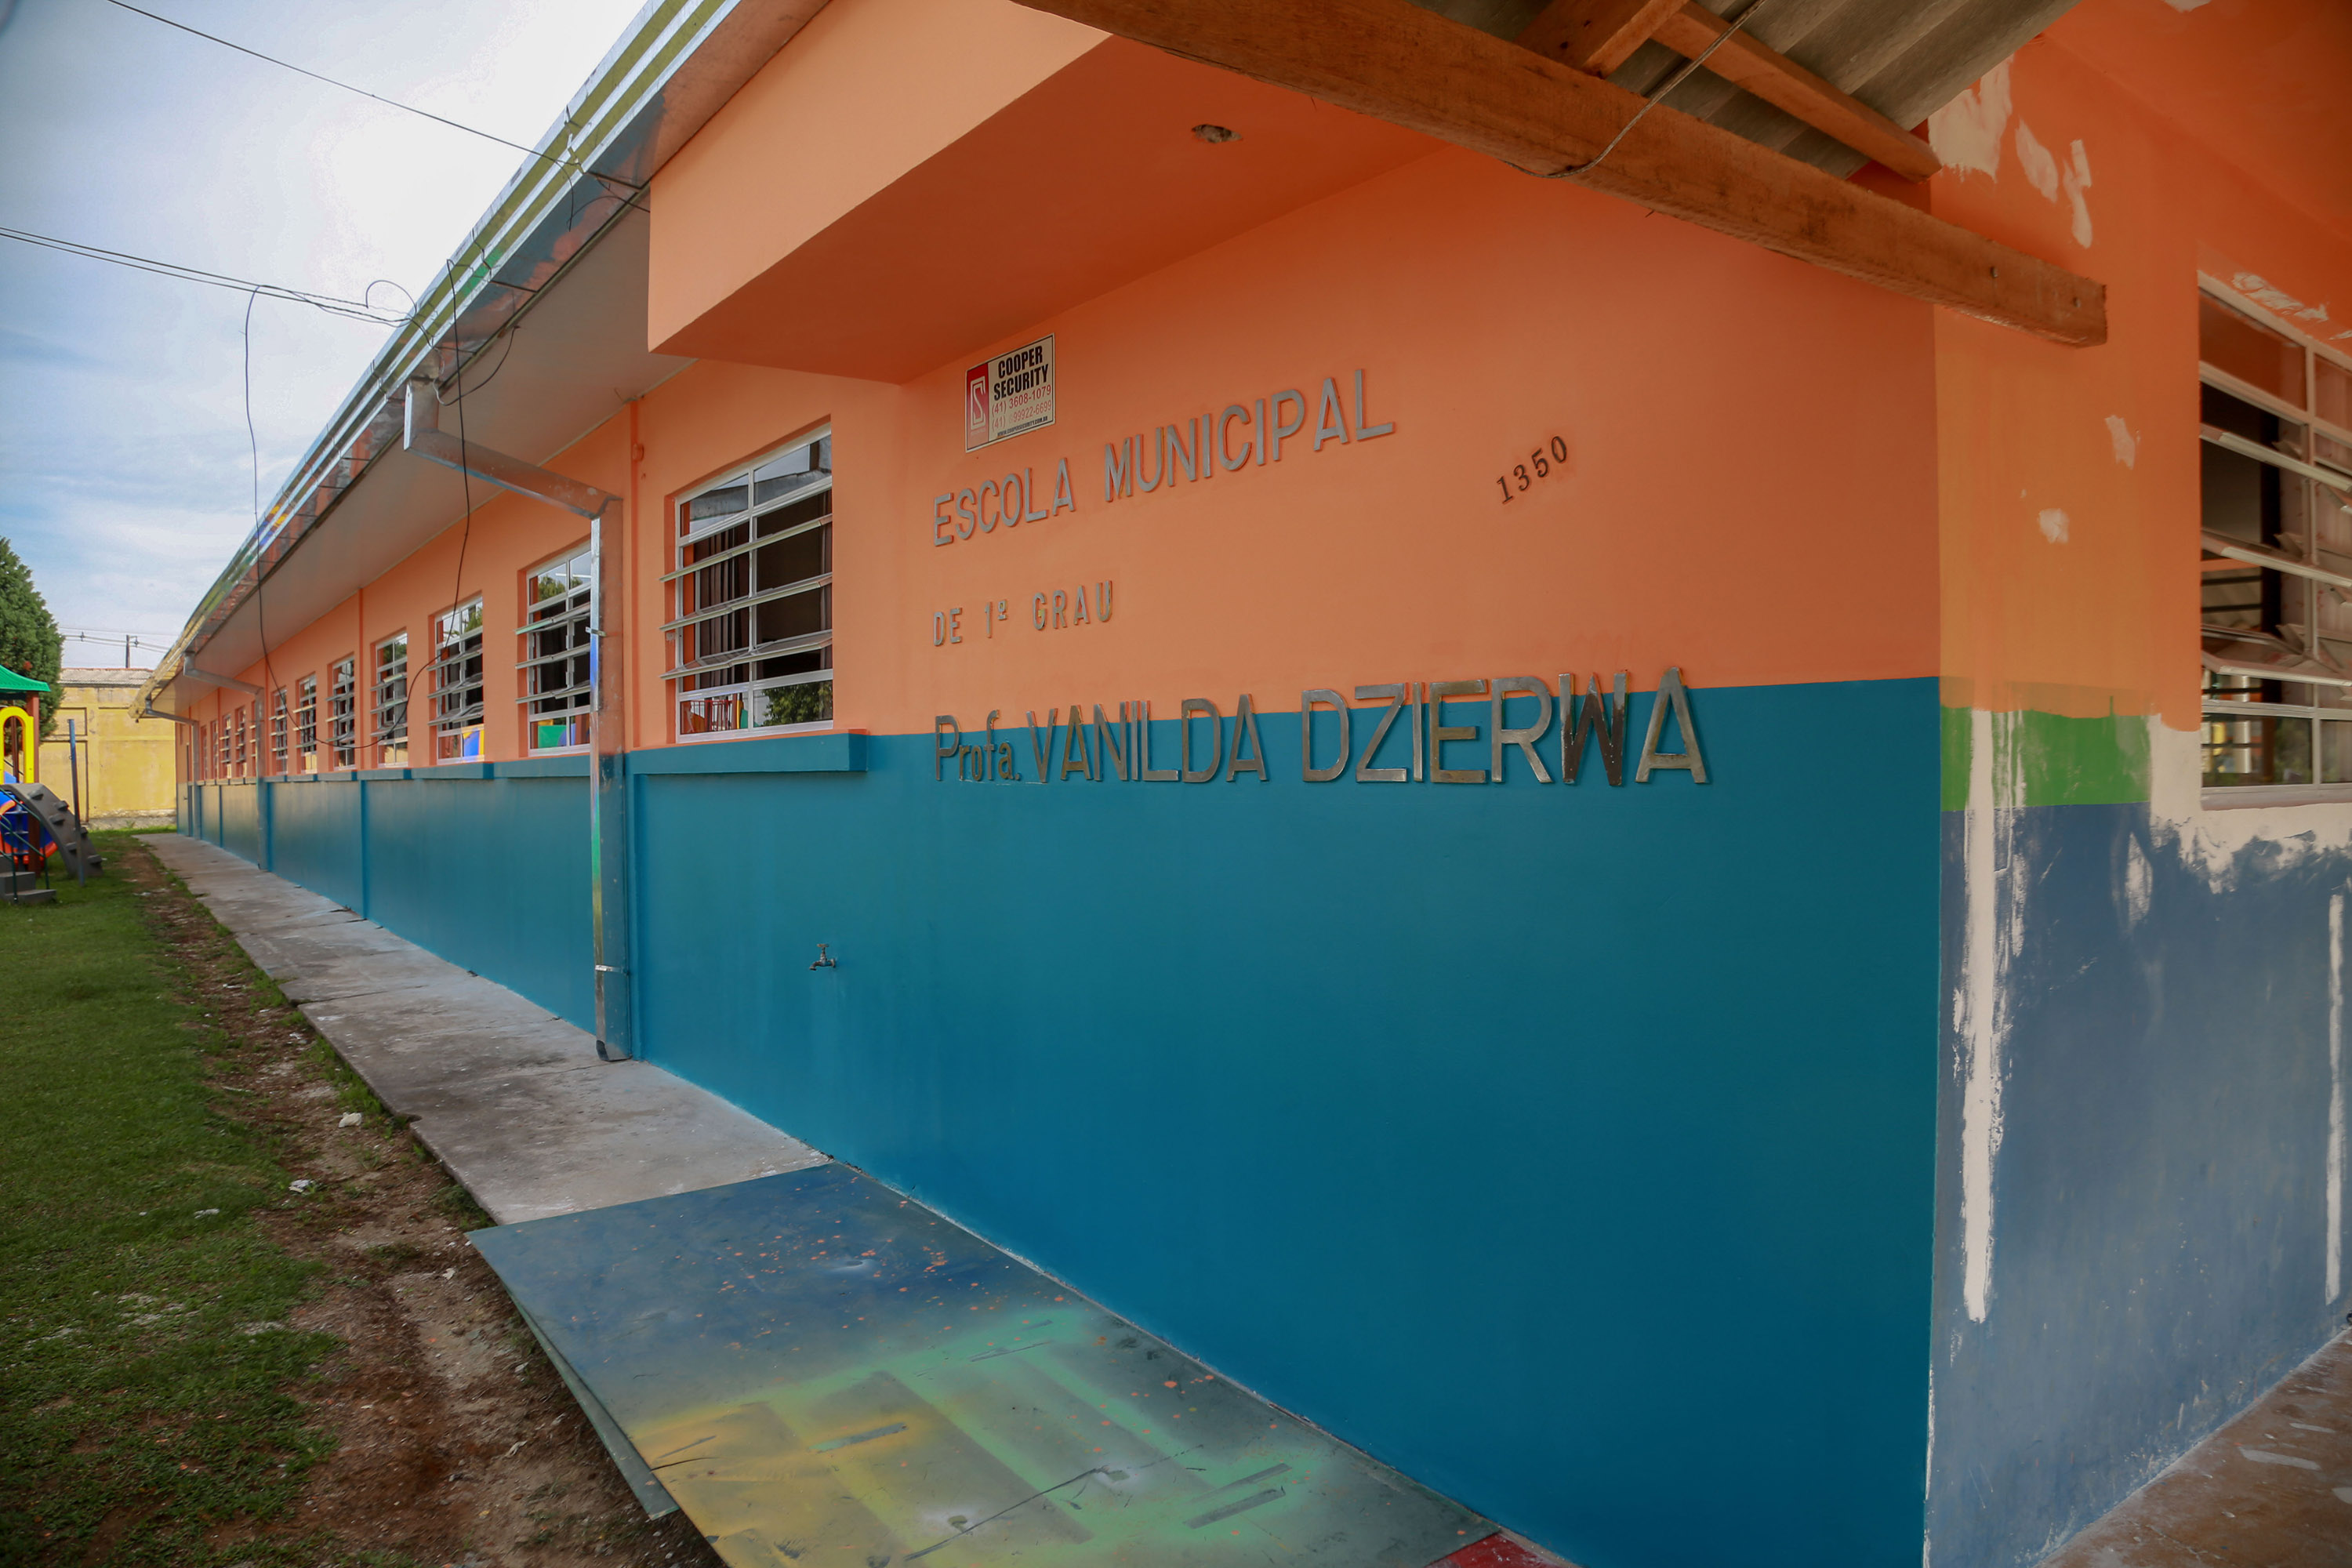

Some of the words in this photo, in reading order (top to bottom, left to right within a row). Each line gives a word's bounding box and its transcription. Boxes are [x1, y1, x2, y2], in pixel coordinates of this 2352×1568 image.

[993, 363, 1049, 401] SECURITY
[998, 345, 1043, 379] COOPER
[992, 401, 1007, 417] (41)
[1009, 384, 1051, 409] 3608-1079
[992, 416, 1006, 432] (41)
[1014, 400, 1051, 423] 99922-6699
[934, 457, 1076, 546] ESCOLA
[1104, 369, 1396, 503] MUNICIPAL
[1496, 434, 1568, 504] 1350
[934, 608, 963, 647] DE
[1032, 580, 1112, 631] GRAU
[935, 710, 1021, 782] Profa.
[1025, 694, 1269, 783] VANILDA
[1301, 667, 1709, 786] DZIERWA
